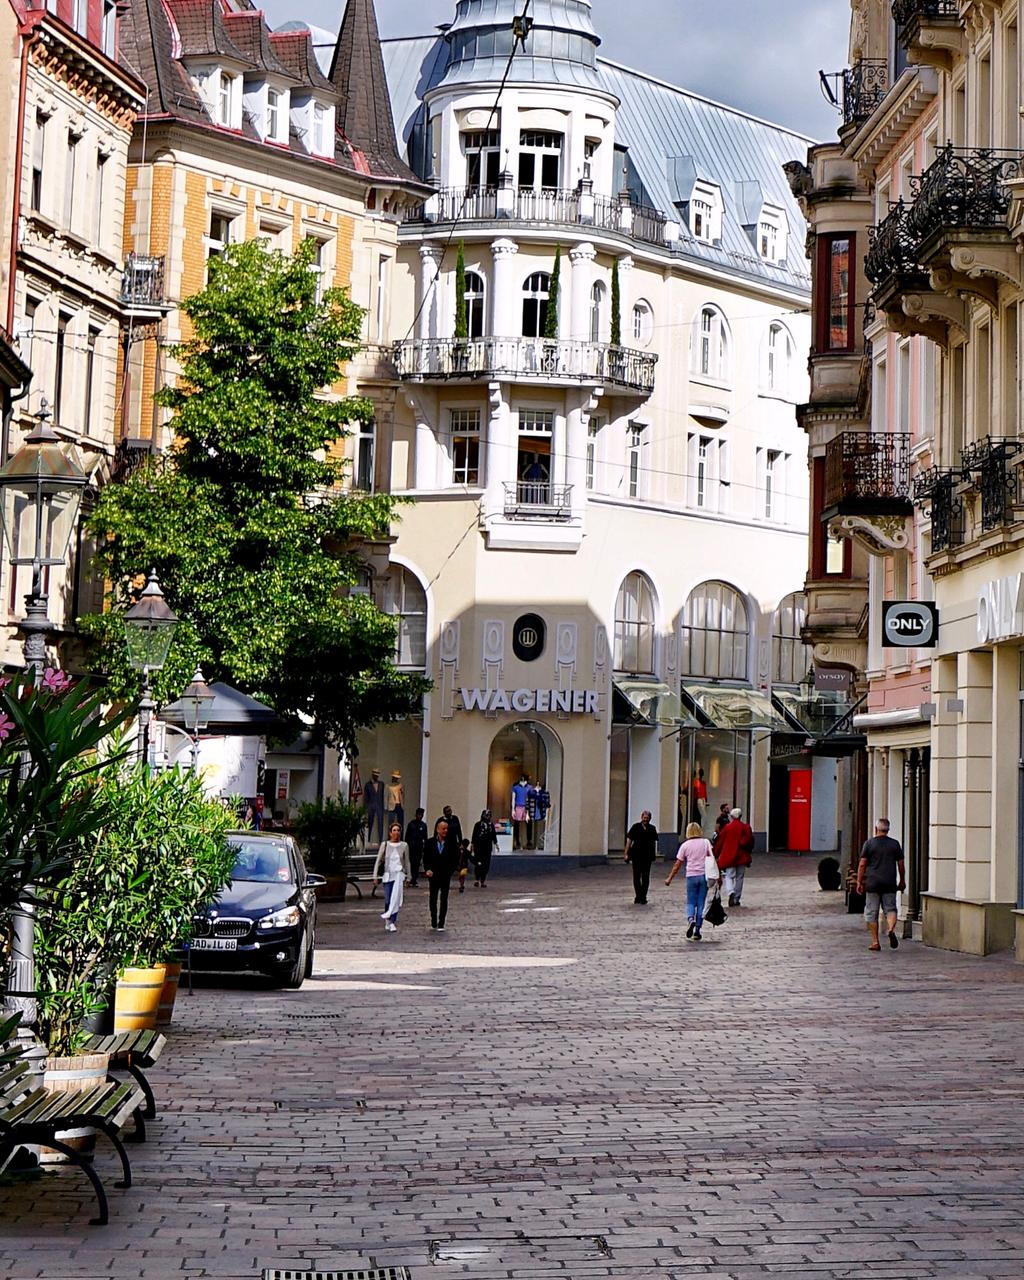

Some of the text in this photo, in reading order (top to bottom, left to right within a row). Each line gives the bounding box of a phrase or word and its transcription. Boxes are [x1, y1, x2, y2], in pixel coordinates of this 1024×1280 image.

[887, 618, 930, 631] ONLY
[818, 673, 846, 681] orsay
[461, 687, 600, 713] WAGENER
